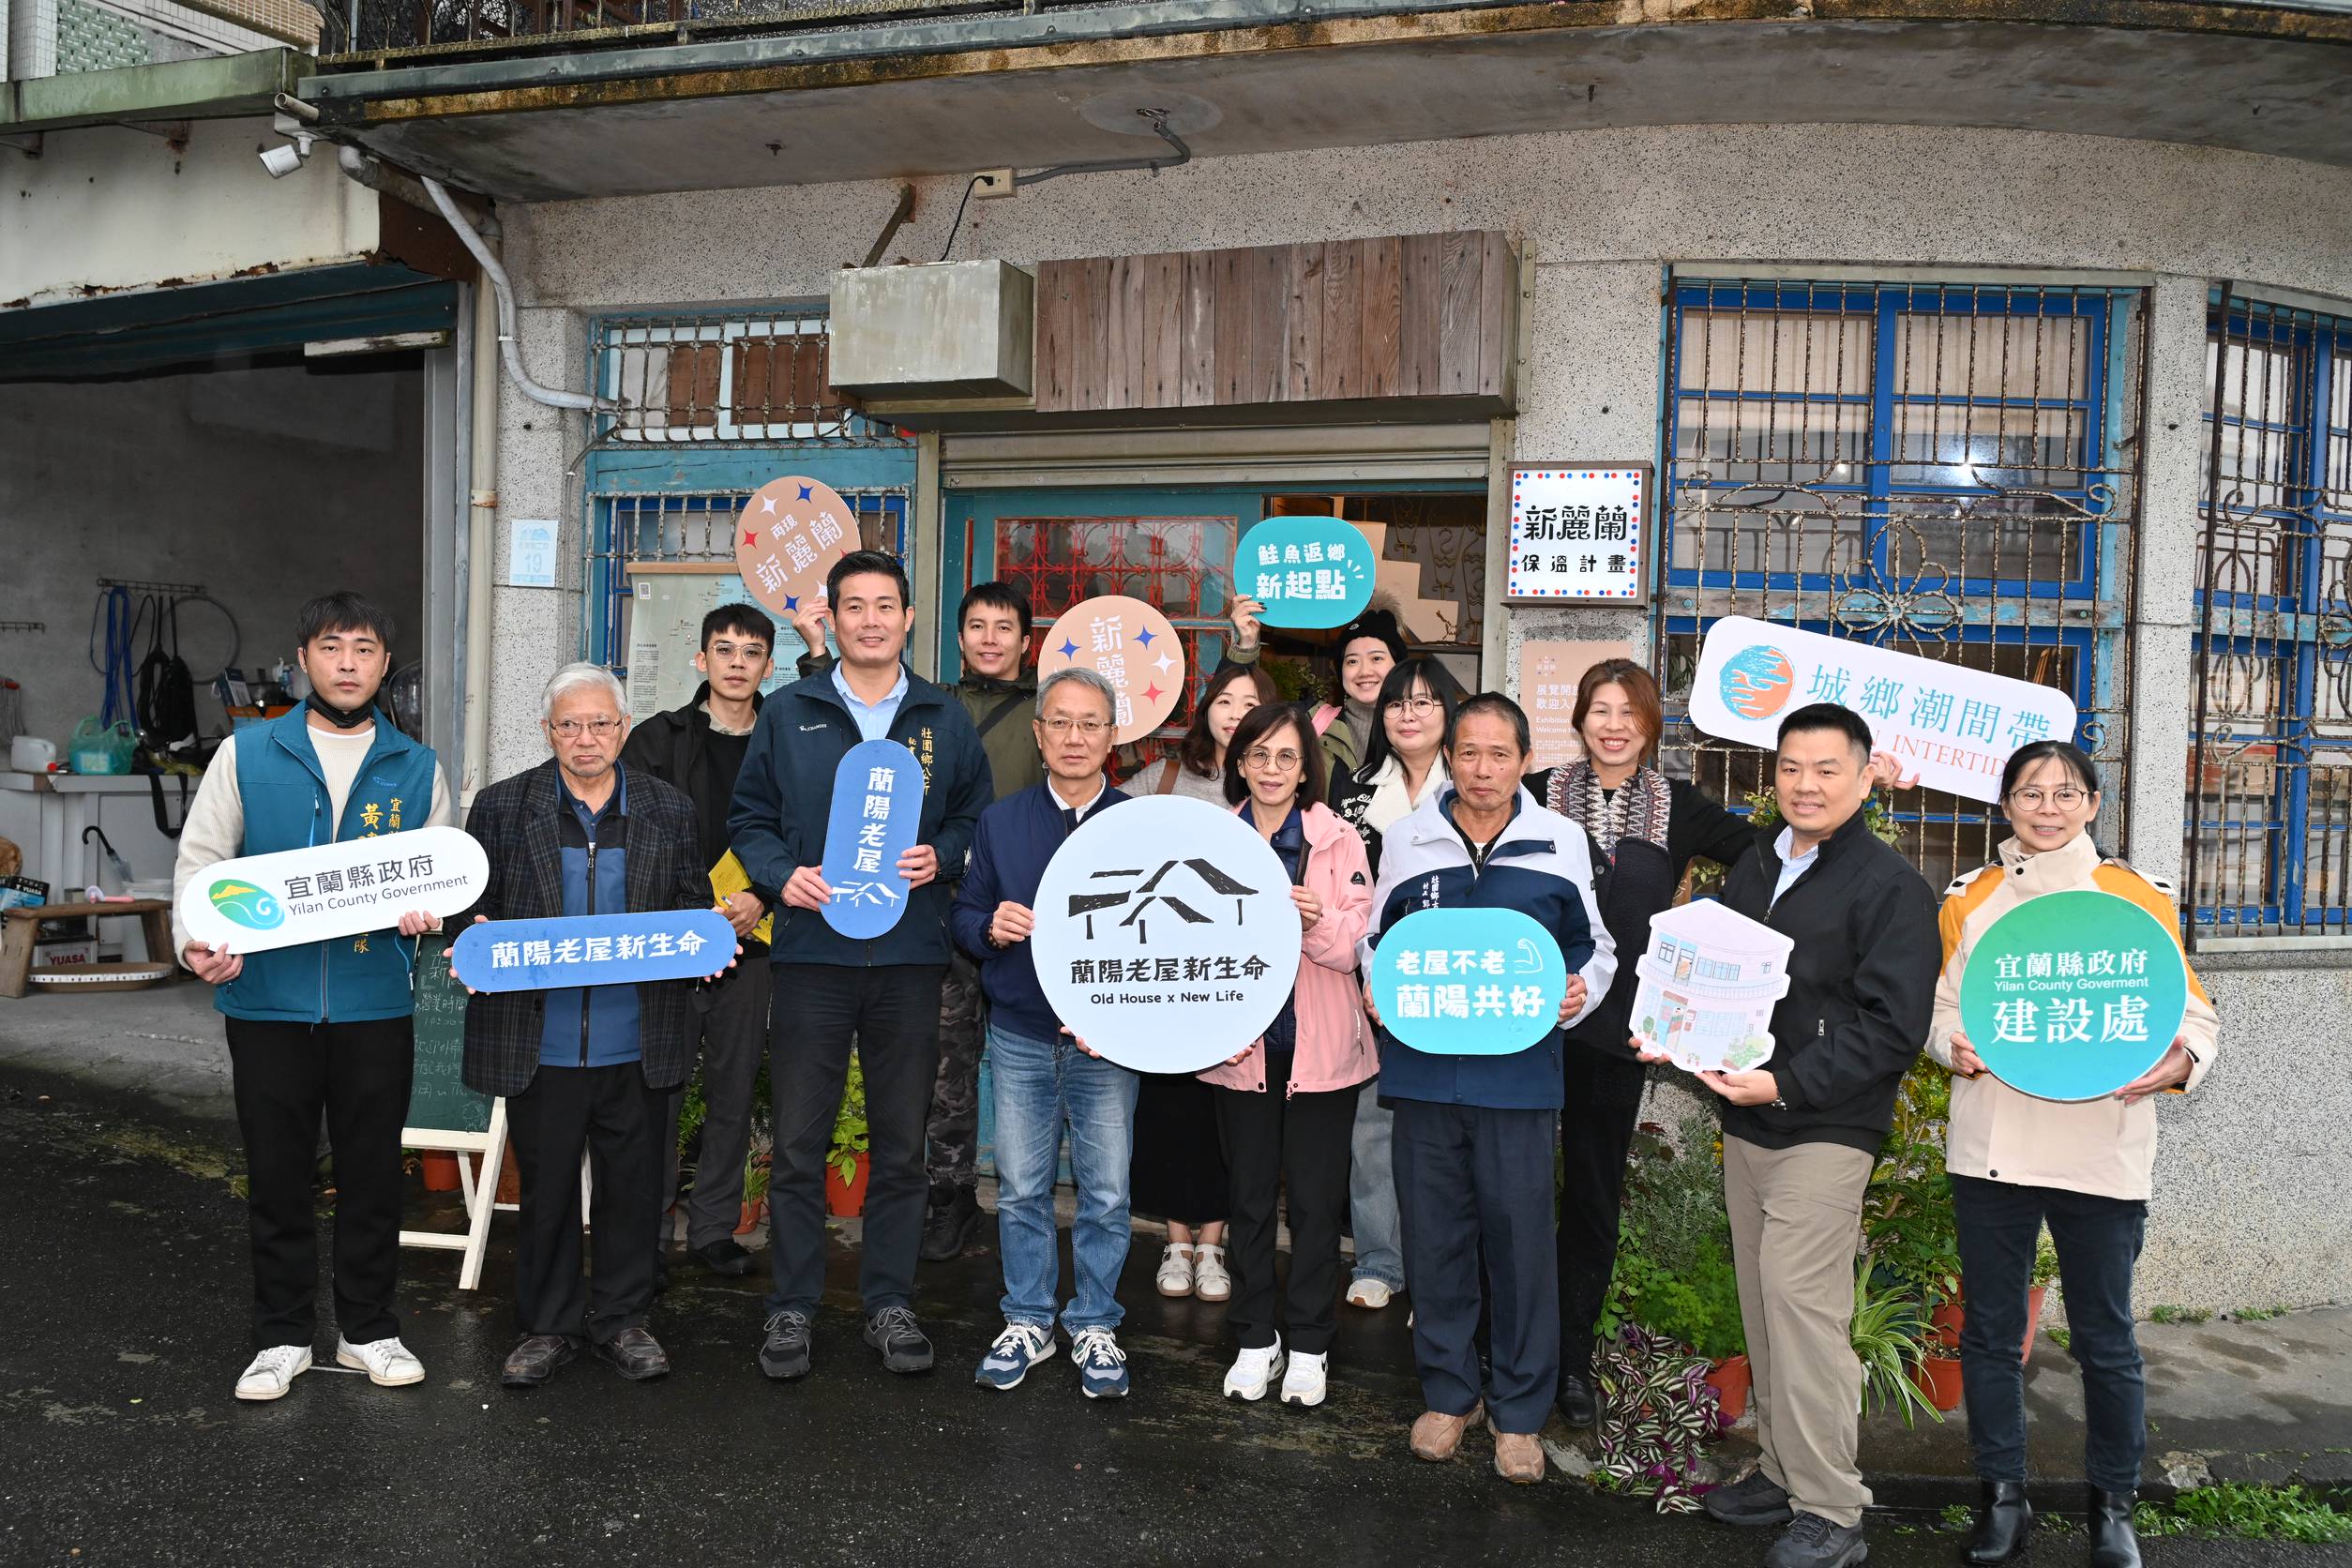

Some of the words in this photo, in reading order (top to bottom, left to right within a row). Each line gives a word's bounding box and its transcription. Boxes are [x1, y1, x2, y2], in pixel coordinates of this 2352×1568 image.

[1523, 505, 1627, 541] 新麗蘭
[525, 552, 542, 574] 19
[755, 510, 844, 594] 新麗蘭
[1258, 541, 1346, 566] 鮭魚返鄉
[1521, 554, 1626, 573] 保溫計畫
[1256, 569, 1346, 600] 新起點
[1536, 698, 1576, 710] 歡迎入
[1806, 664, 2051, 747] 城鄉潮間帶
[1892, 734, 2007, 777] INTERTID
[388, 797, 403, 835] 宜蘭
[852, 766, 896, 874] 蘭陽老屋
[284, 854, 434, 900] 宜蘭縣政府
[289, 902, 324, 916] Yilan
[327, 893, 377, 910] County
[382, 874, 469, 900] Government
[50, 955, 85, 966] YUASA
[490, 929, 708, 969] 蘭陽老屋新生命
[1395, 949, 1506, 975] 老屋不老
[1995, 948, 2148, 979] 宜蘭縣政府
[1070, 955, 1272, 984] 蘭陽老屋新生命
[1994, 981, 2025, 991] Yilan
[2028, 979, 2073, 993] County
[2076, 977, 2149, 990] Goverment
[1091, 993, 1114, 1004] Old
[1120, 992, 1162, 1003] House
[1181, 991, 1211, 1003] New
[1216, 990, 1244, 1002] Life
[1396, 984, 1545, 1019] 蘭陽共好
[1991, 995, 2149, 1044] 建設處
